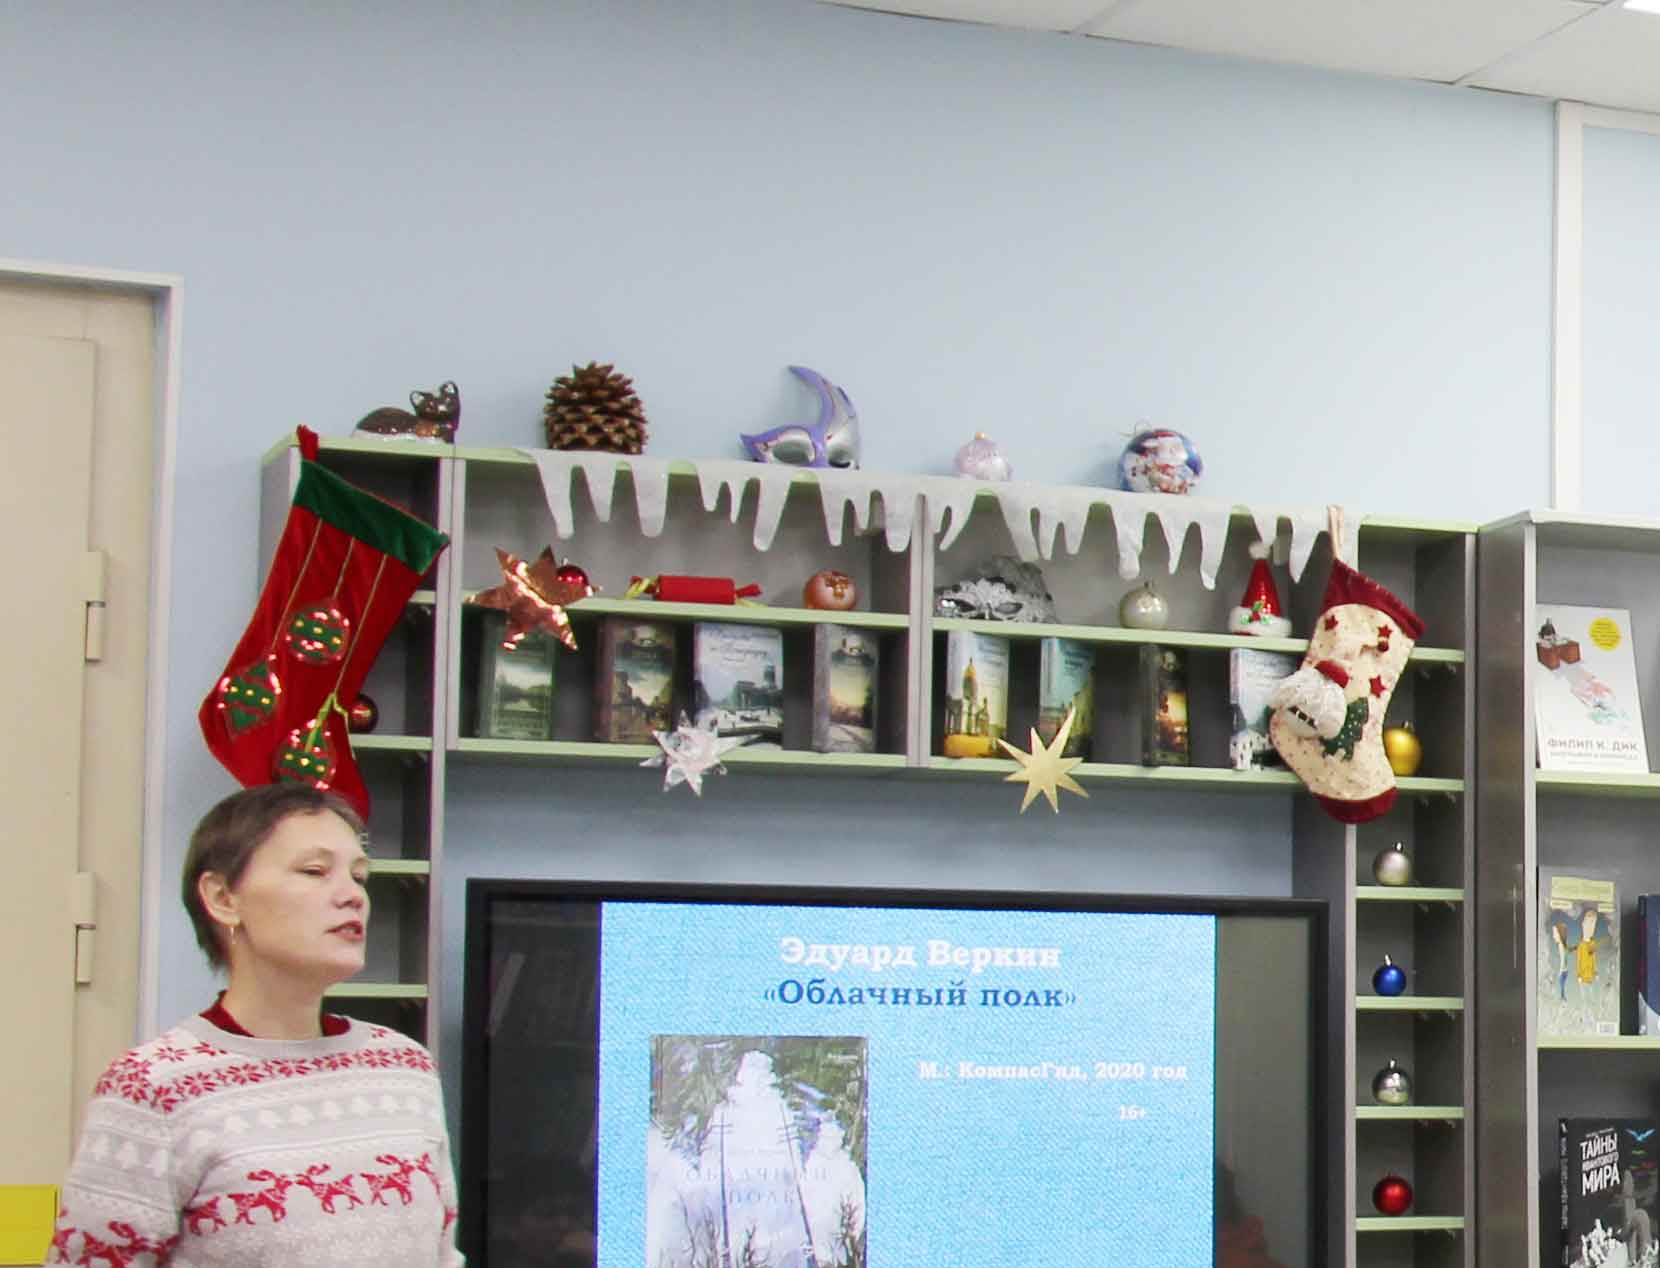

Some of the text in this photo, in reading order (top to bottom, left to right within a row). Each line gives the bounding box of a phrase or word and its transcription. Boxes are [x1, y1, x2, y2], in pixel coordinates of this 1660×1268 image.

[780, 937, 1061, 974] Эдуард Веркин
[764, 979, 1076, 1008] «Облачный полк»
[1095, 1062, 1145, 1079] 2020
[1152, 1064, 1187, 1082] год
[1580, 1133, 1618, 1161] ТАЙНЫ
[1582, 1162, 1620, 1196] МИРА
